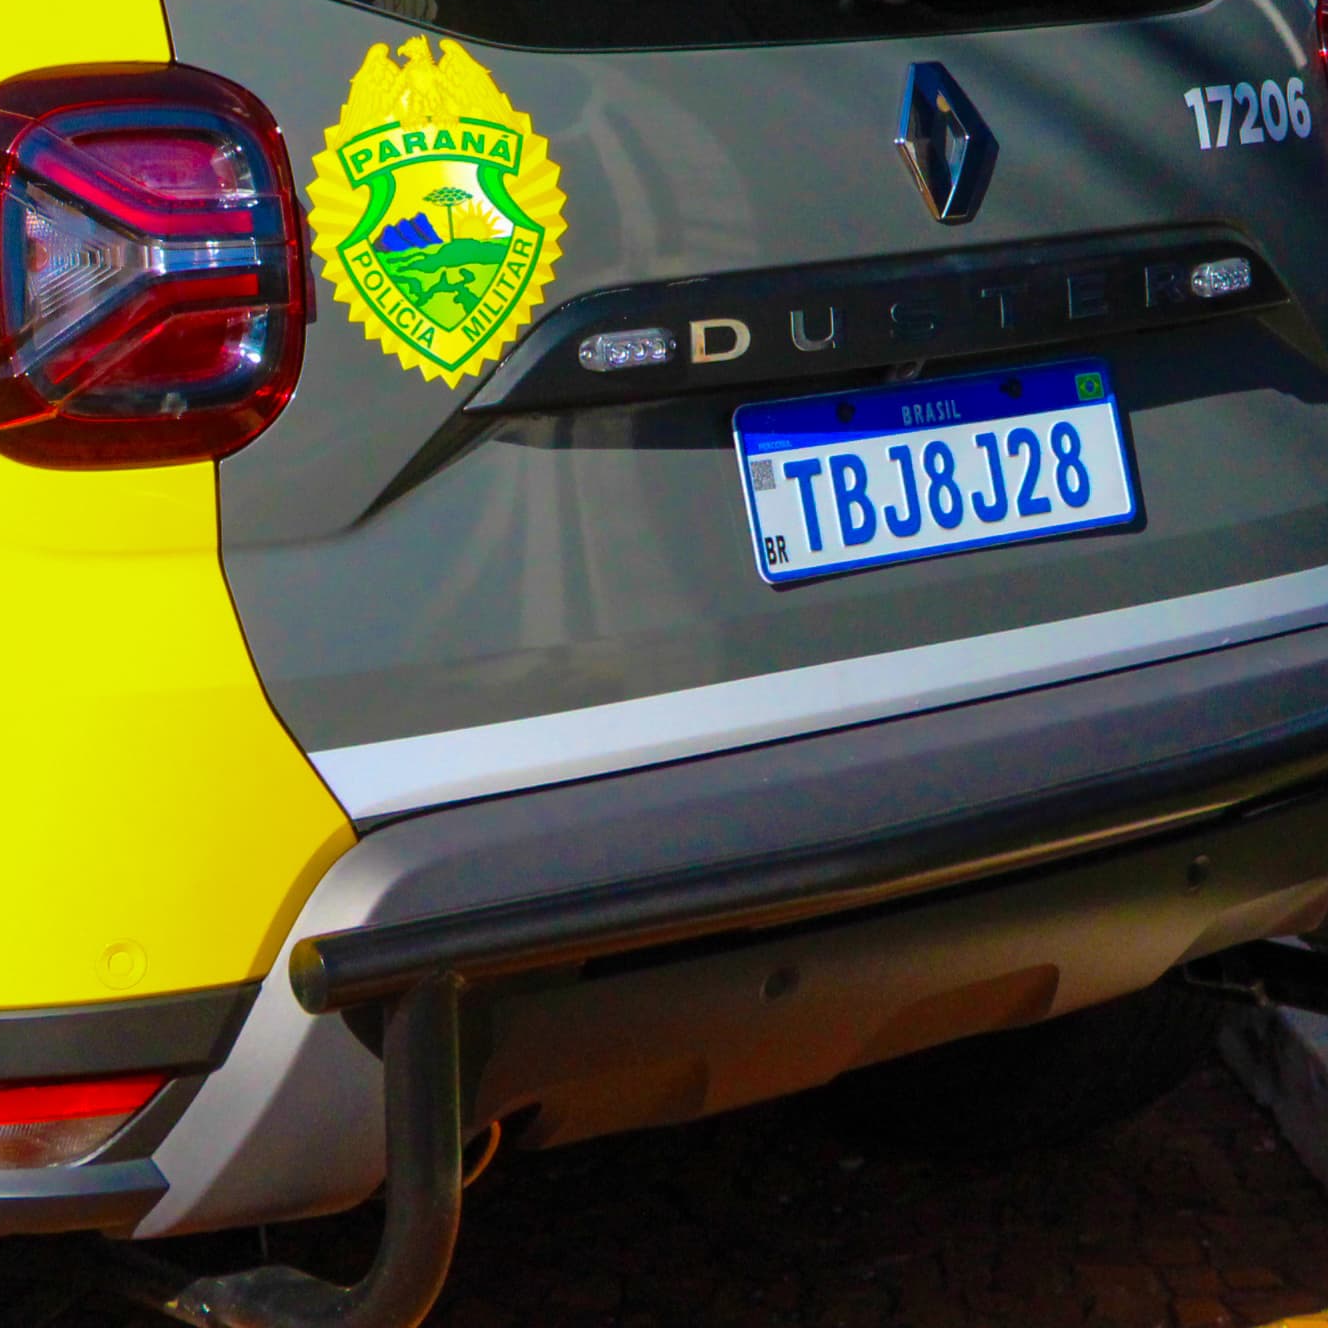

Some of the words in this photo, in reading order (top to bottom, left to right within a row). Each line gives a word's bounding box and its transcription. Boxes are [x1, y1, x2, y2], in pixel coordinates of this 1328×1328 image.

[1184, 77, 1312, 150] 17206
[349, 130, 512, 174] PARANÁ
[352, 251, 436, 349] POLÍCIA
[461, 237, 533, 343] MILITAR
[690, 266, 1176, 363] DUSTER
[902, 399, 961, 426] BRASIL
[783, 421, 1091, 552] TBJ8J28
[765, 535, 789, 565] BR
